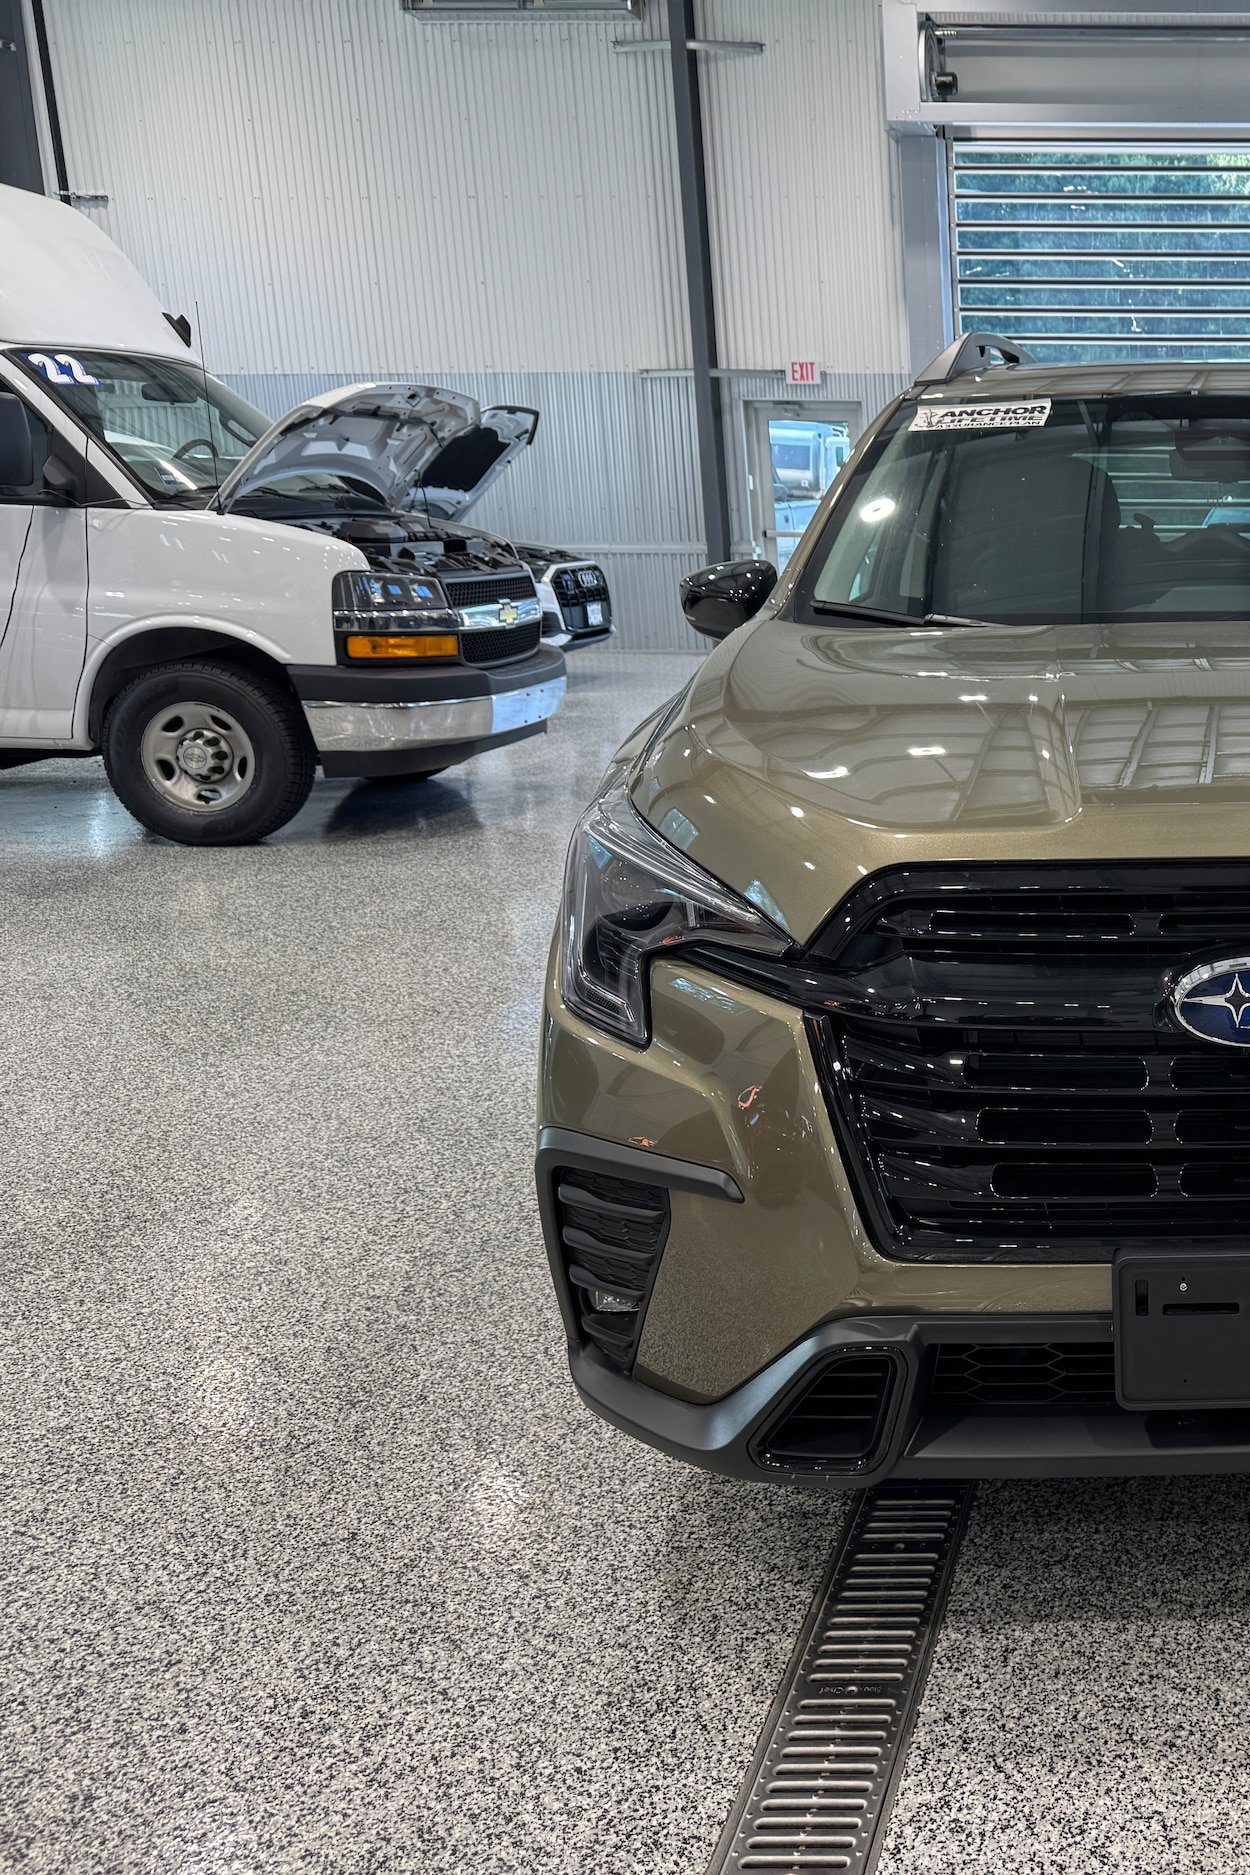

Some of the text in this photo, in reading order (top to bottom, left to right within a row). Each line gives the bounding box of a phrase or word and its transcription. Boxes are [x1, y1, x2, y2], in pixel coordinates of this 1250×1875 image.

[27, 353, 99, 385] 22
[791, 361, 816, 382] EXIT
[936, 415, 1043, 425] LIFETIME
[939, 405, 1047, 418] ANCHOR
